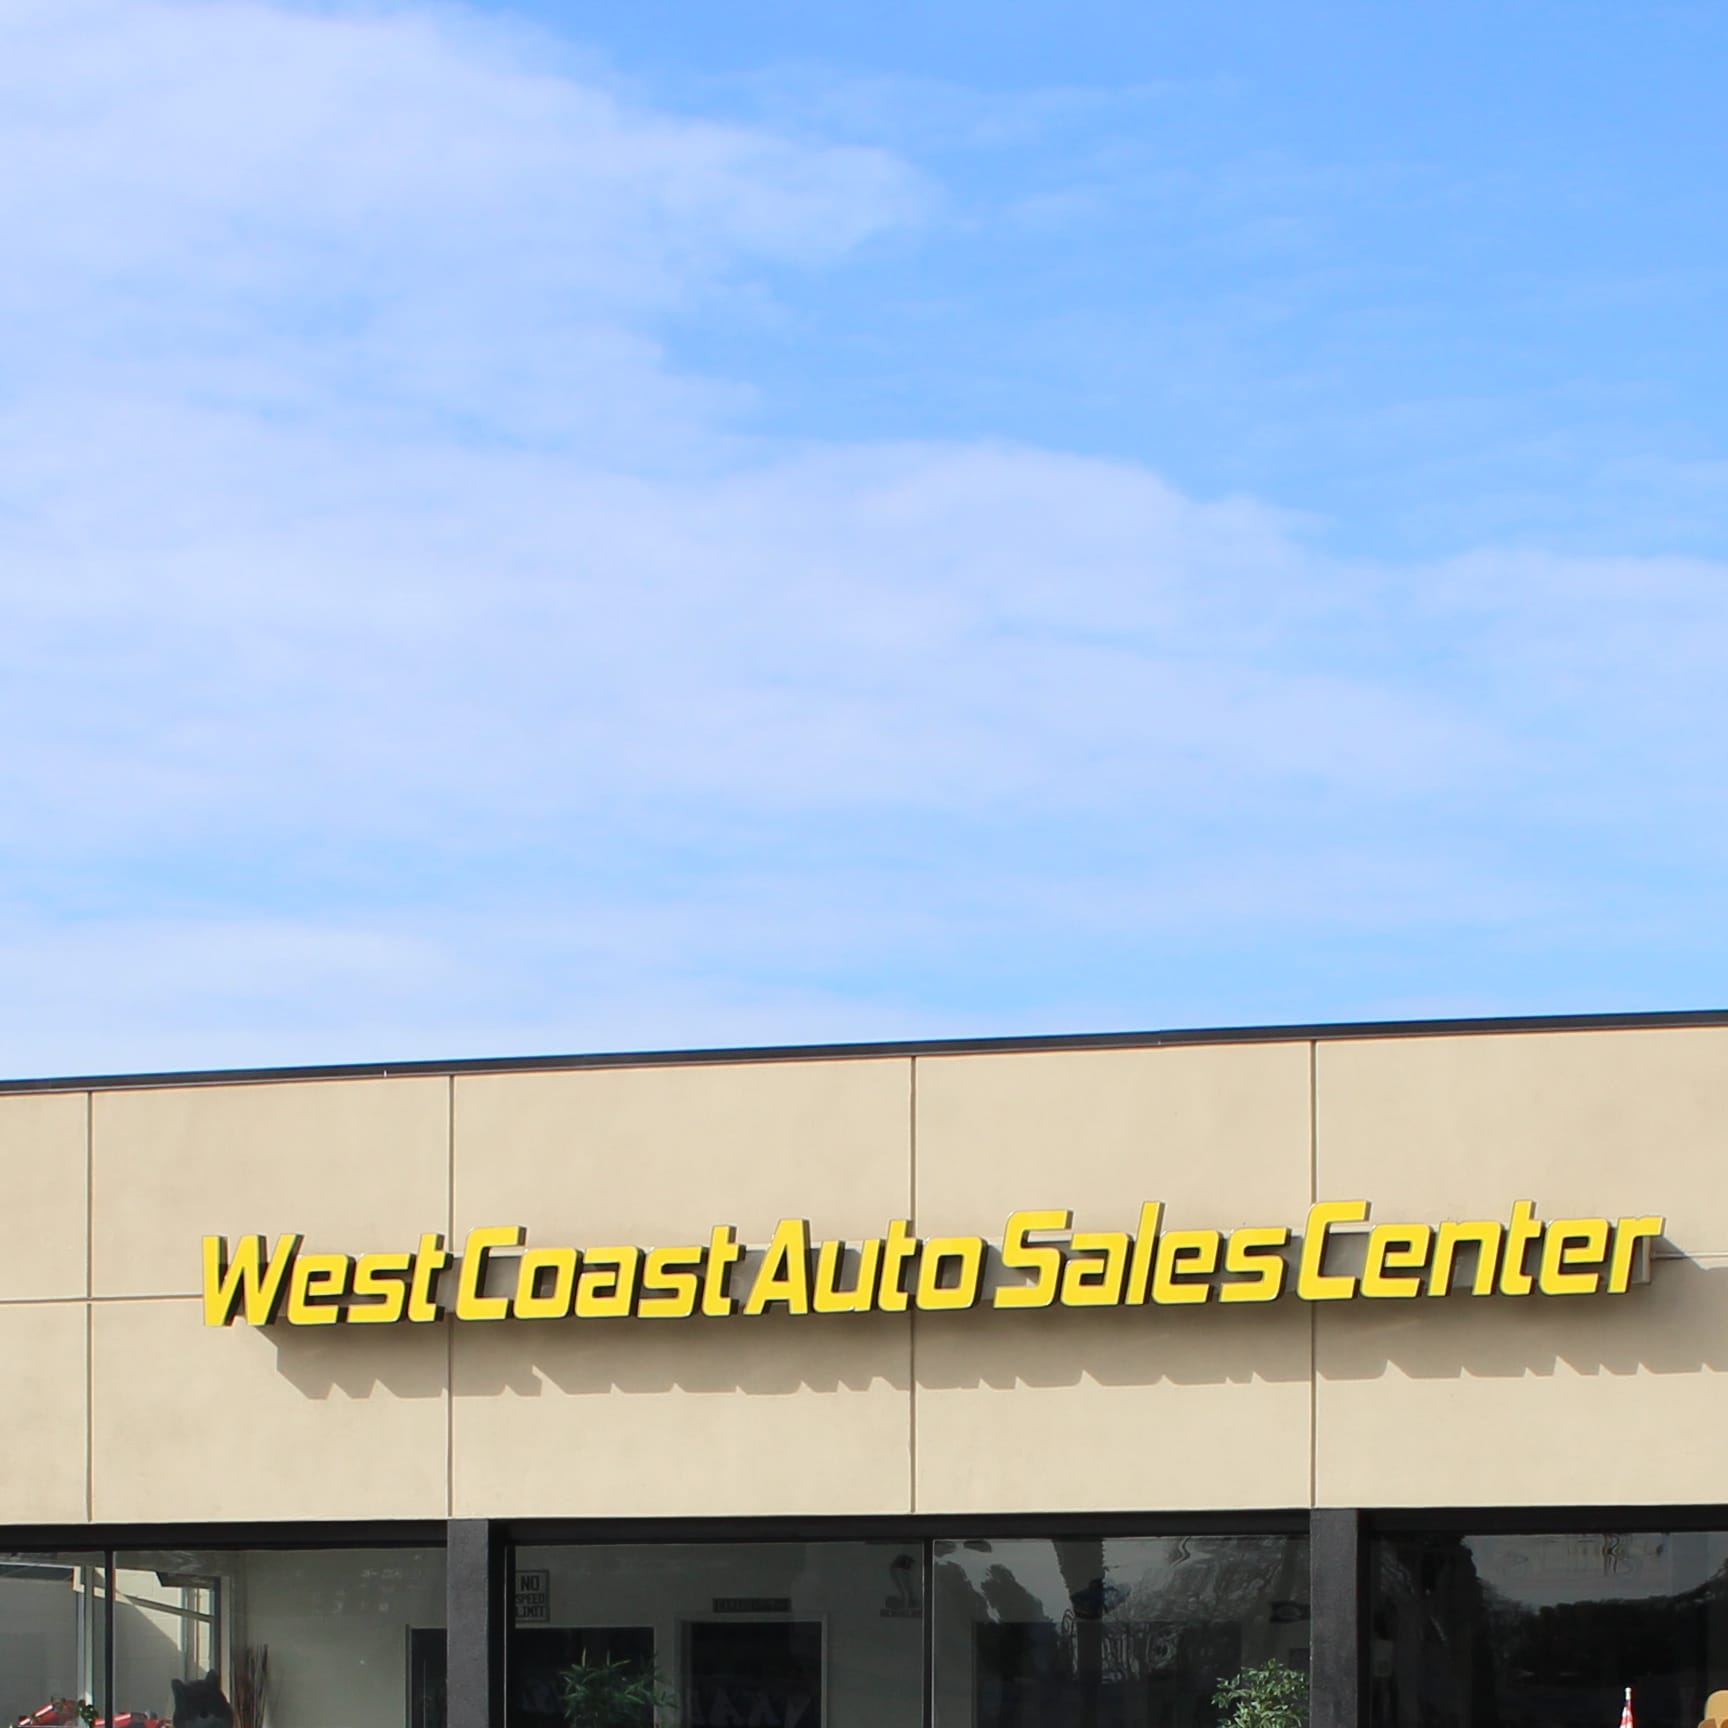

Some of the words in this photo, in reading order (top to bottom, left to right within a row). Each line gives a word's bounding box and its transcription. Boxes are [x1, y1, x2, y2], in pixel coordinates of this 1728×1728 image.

[202, 1233, 444, 1326] West
[456, 1225, 738, 1322] Coast
[743, 1218, 984, 1316] Auto
[993, 1201, 1291, 1308] Sales
[1296, 1201, 1665, 1300] Center
[521, 1575, 540, 1591] NO
